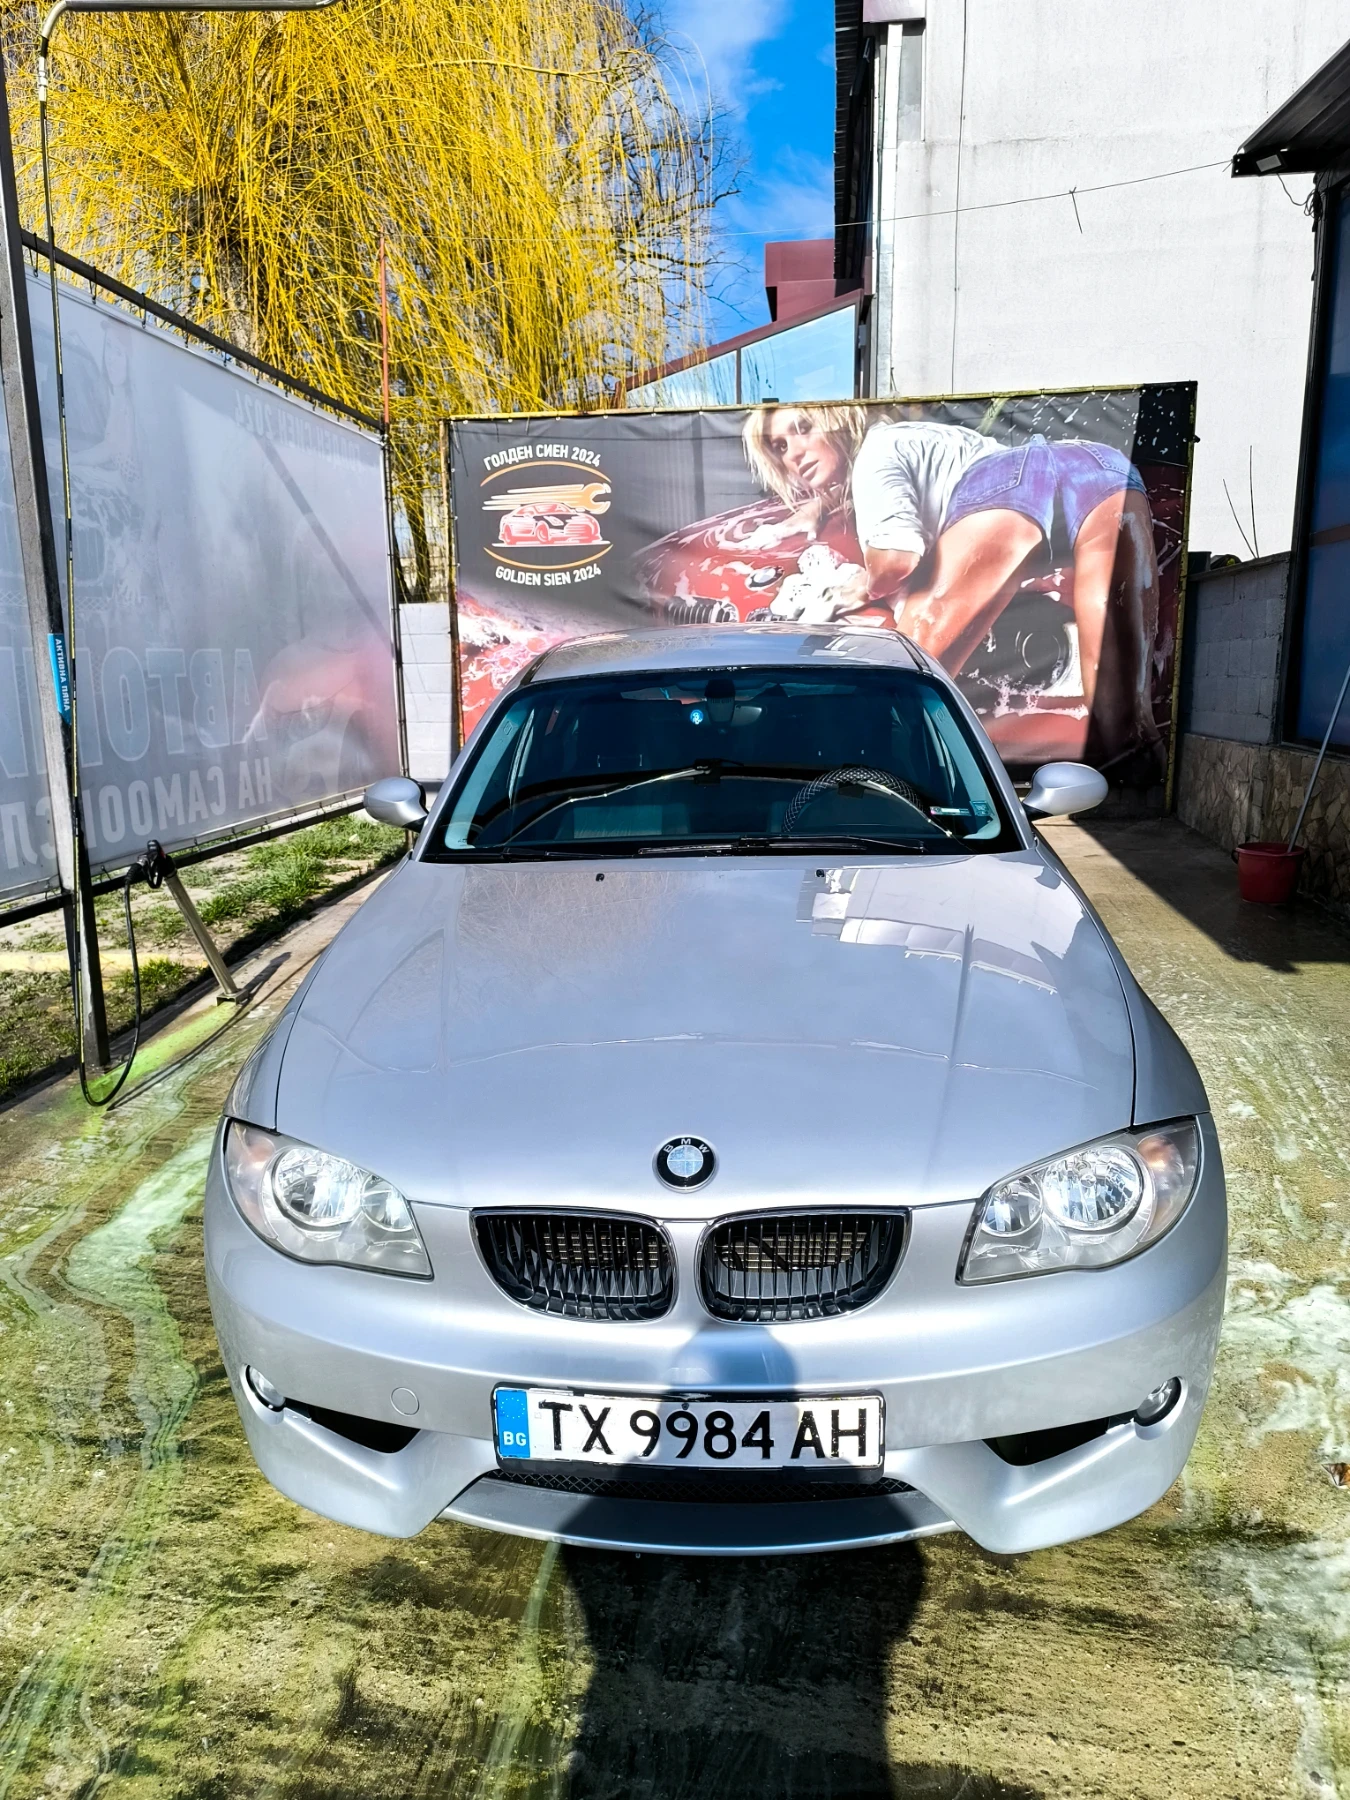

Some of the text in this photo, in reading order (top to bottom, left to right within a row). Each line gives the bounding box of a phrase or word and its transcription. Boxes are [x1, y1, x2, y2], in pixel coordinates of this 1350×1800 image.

[483, 444, 602, 471] ГОЛДЕН СИЕН 2024
[495, 563, 602, 587] GOLDEN SIEN 2024
[55, 638, 71, 711] АКТИВНА ПЯНА
[663, 1138, 710, 1153] BMW
[503, 1431, 527, 1448] BG
[629, 1409, 775, 1461] 9984
